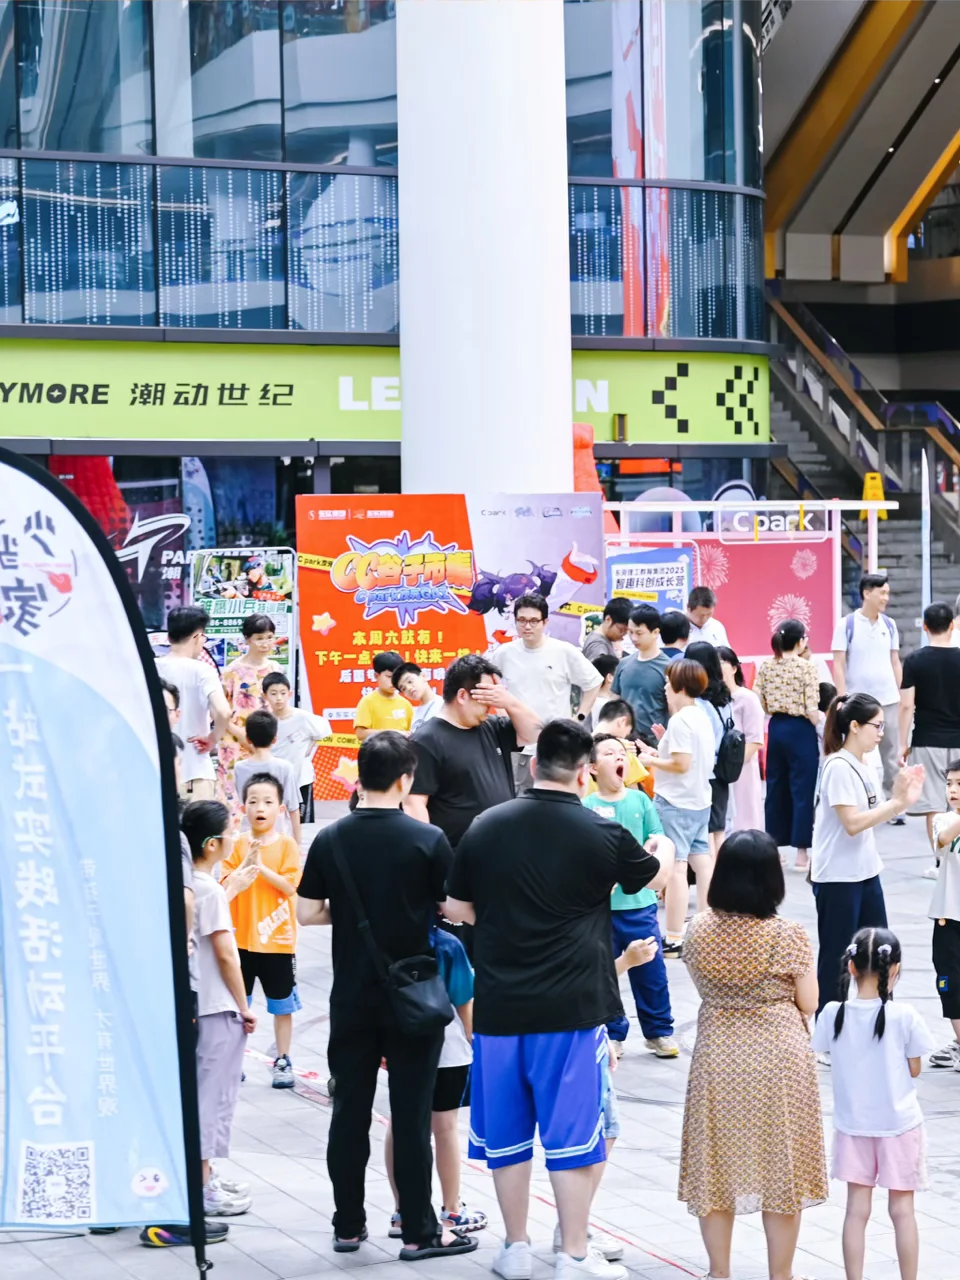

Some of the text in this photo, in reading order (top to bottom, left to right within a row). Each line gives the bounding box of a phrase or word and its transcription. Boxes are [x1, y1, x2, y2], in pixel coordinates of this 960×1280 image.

[0, 382, 294, 406] YMORE 潮动世纪
[733, 504, 814, 542] C park
